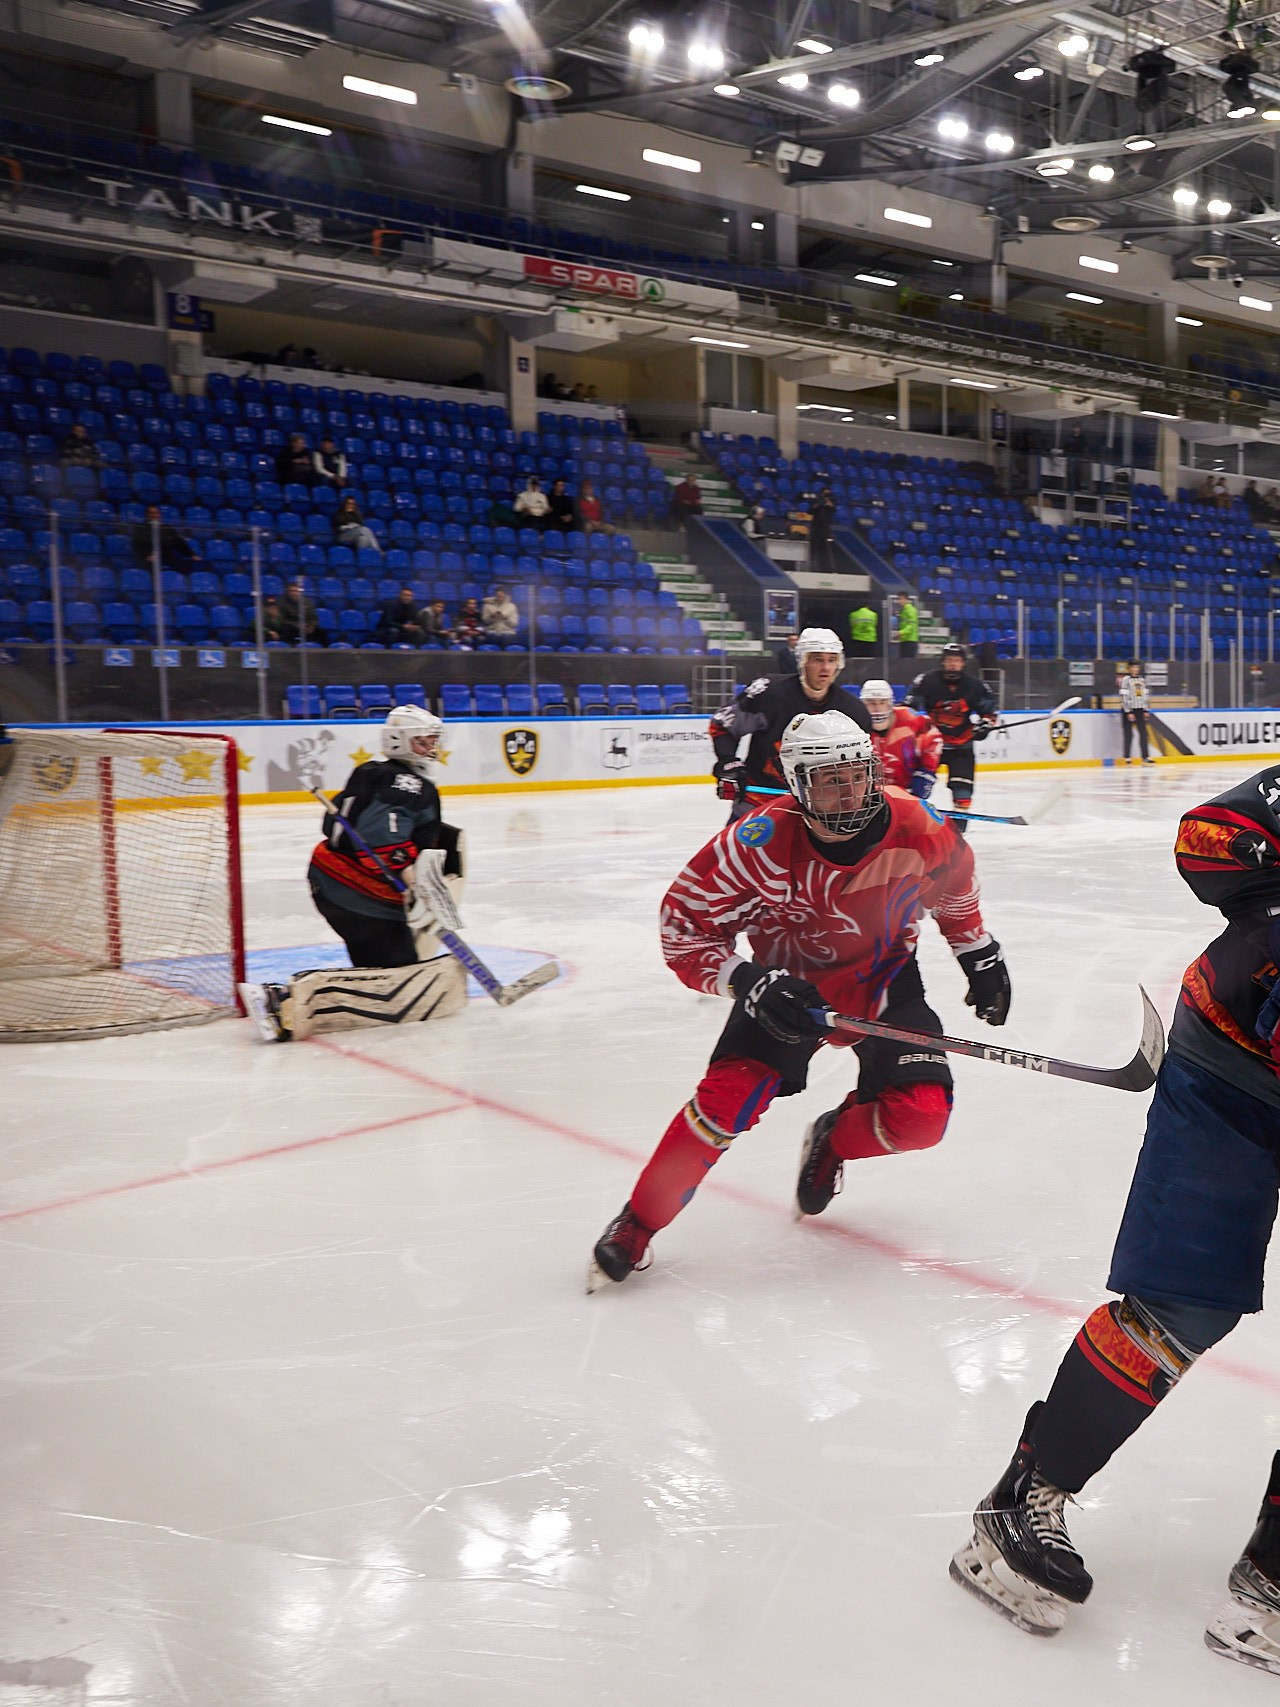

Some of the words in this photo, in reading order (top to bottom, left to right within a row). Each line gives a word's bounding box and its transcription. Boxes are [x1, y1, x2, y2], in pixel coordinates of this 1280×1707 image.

[86, 175, 281, 236] TANK
[551, 266, 635, 294] SPAR
[983, 1047, 1050, 1074] CCM
